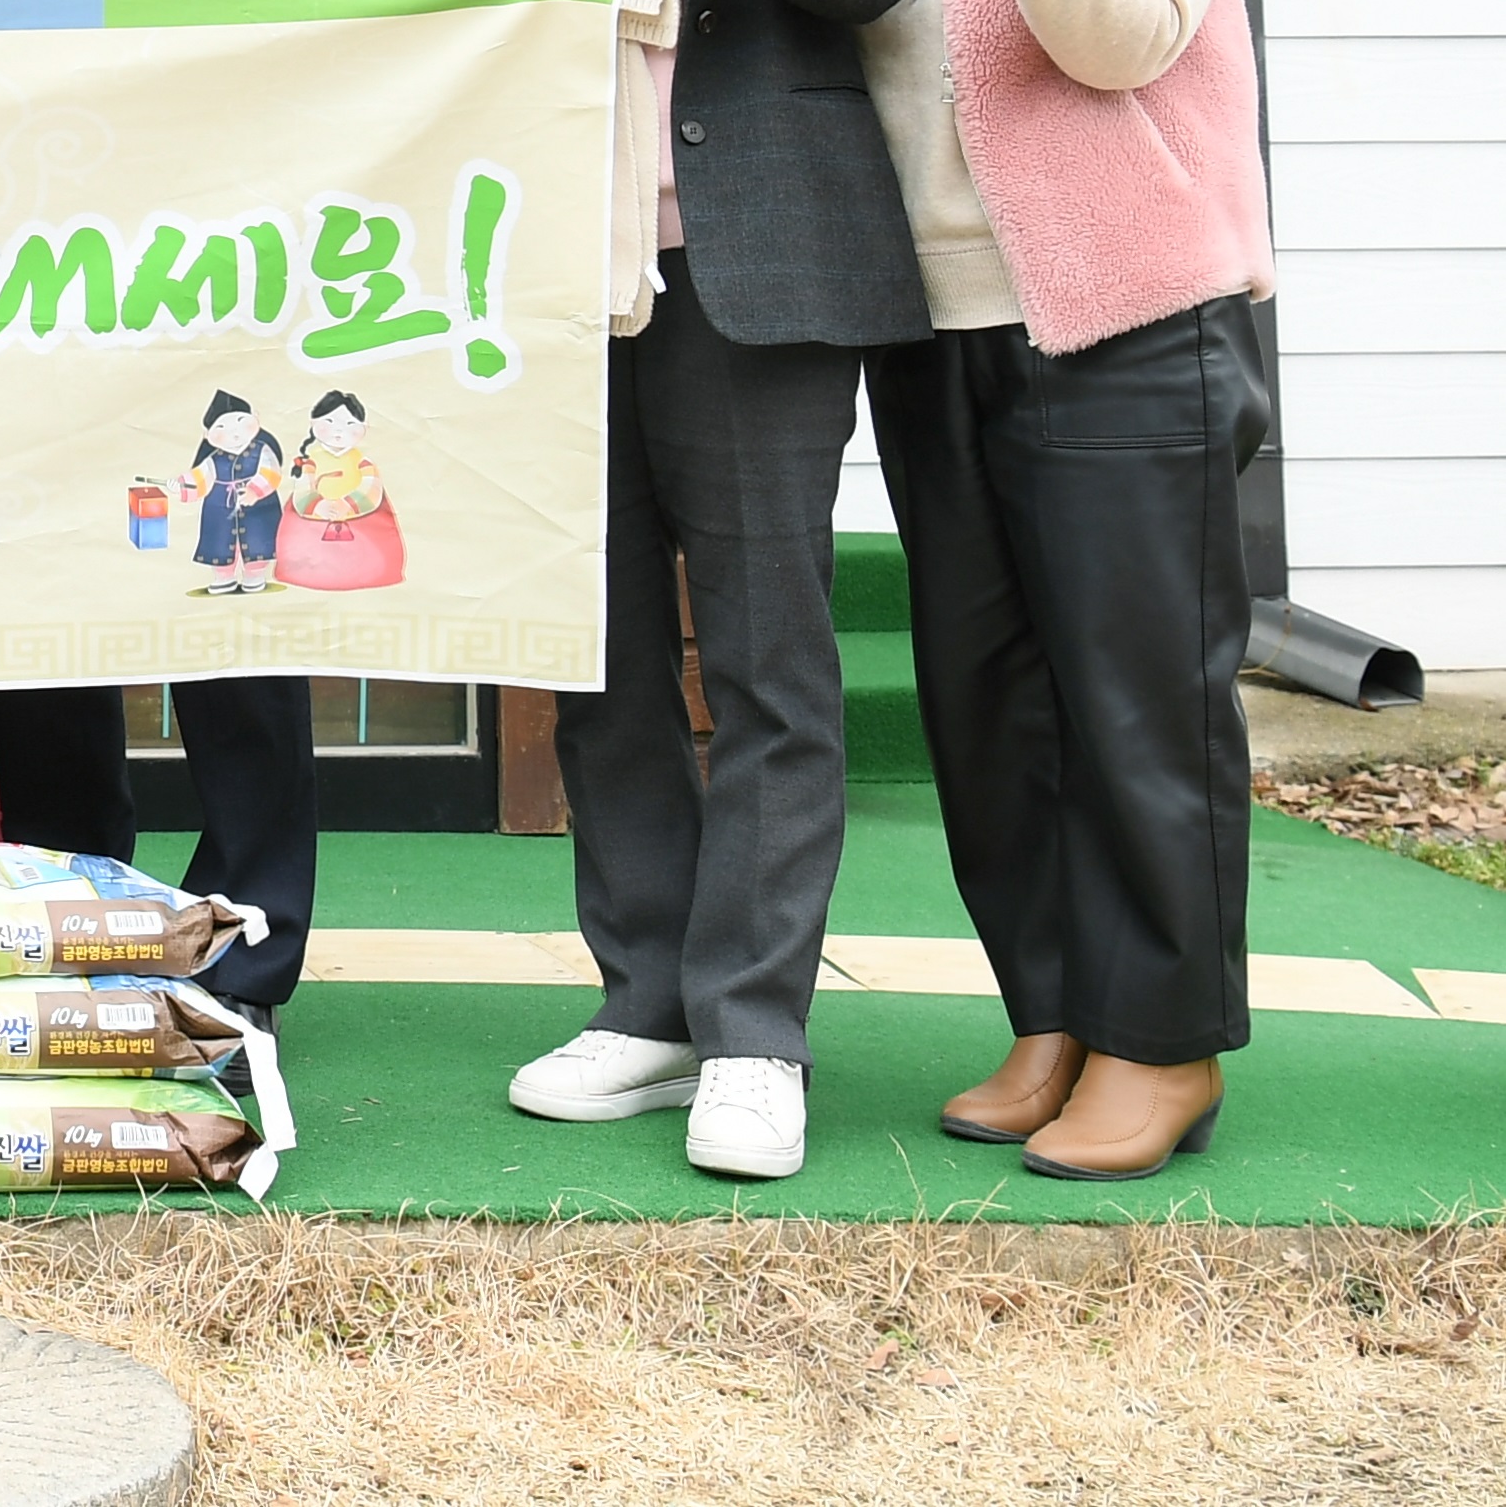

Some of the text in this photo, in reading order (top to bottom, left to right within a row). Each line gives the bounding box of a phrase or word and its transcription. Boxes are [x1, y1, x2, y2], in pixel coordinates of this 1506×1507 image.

[61, 944, 164, 962] 금판영농조합법인
[49, 1037, 156, 1055] 금판영농조합법인
[62, 1157, 169, 1174] 금판영농조합법인
